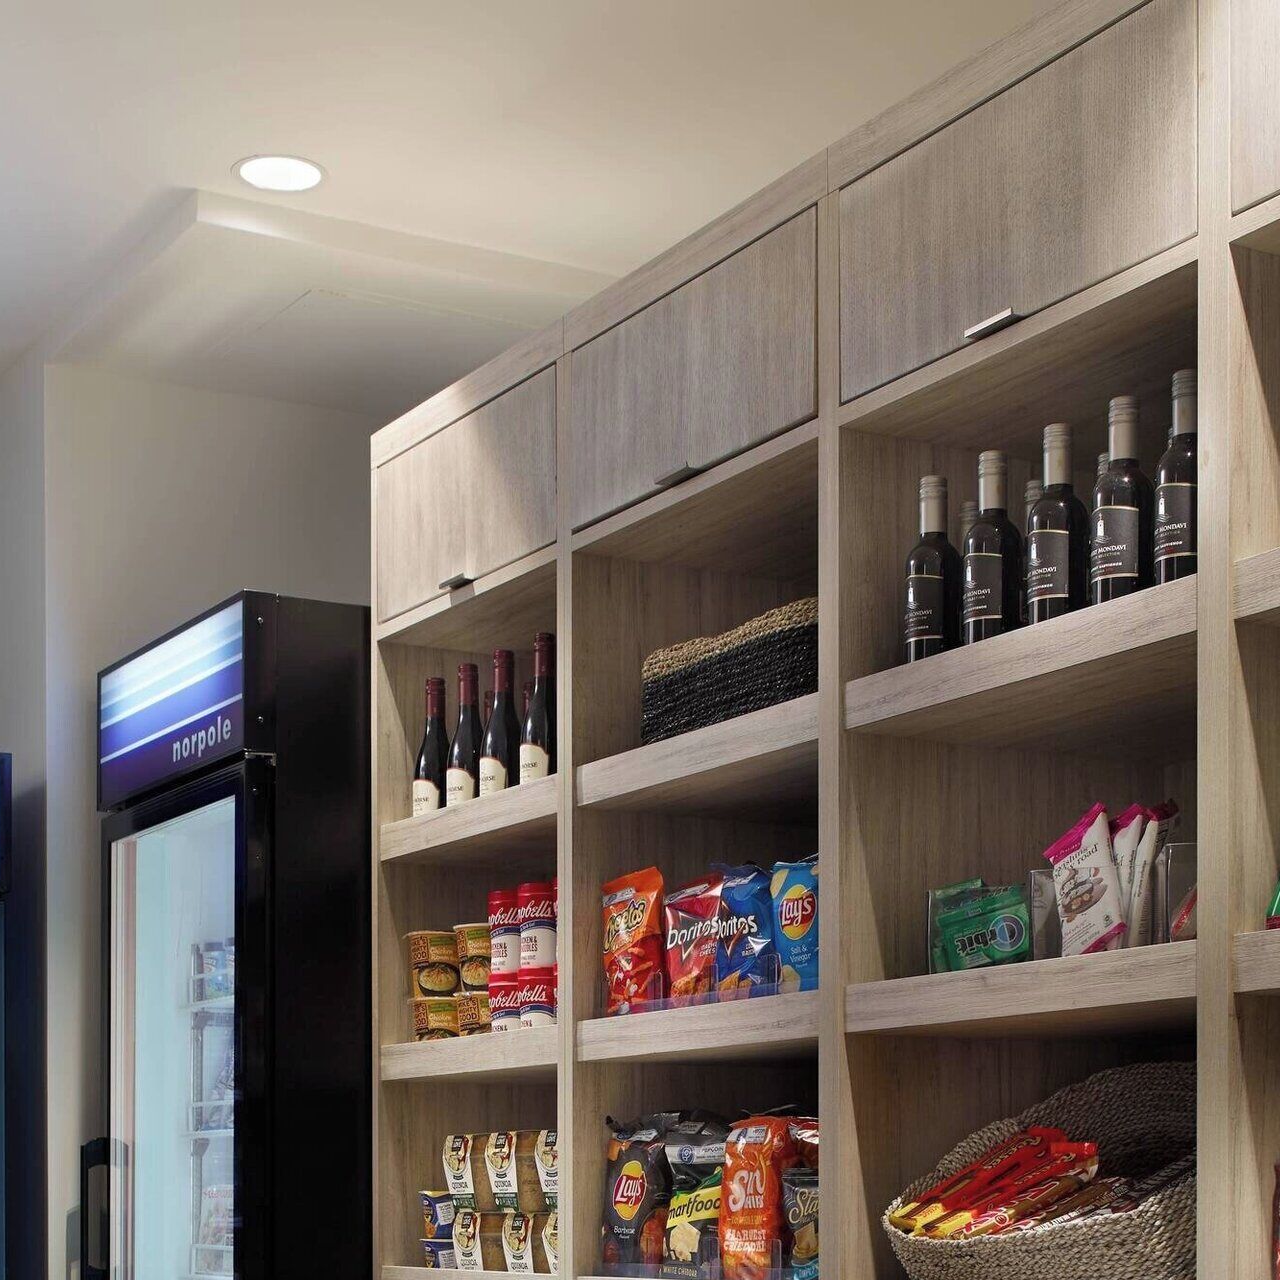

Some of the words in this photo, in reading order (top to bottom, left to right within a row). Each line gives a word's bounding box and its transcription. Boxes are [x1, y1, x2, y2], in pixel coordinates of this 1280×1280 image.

[1160, 523, 1187, 532] MONDAVI
[1098, 545, 1126, 553] MONDAVI
[172, 715, 232, 762] norpole
[781, 893, 816, 925] Lay's
[604, 899, 646, 953] Cheetos
[667, 917, 719, 950] Doritos
[955, 914, 1025, 956] Orbit
[790, 953, 812, 962] Vinegar
[725, 1229, 766, 1240] HARVEST
